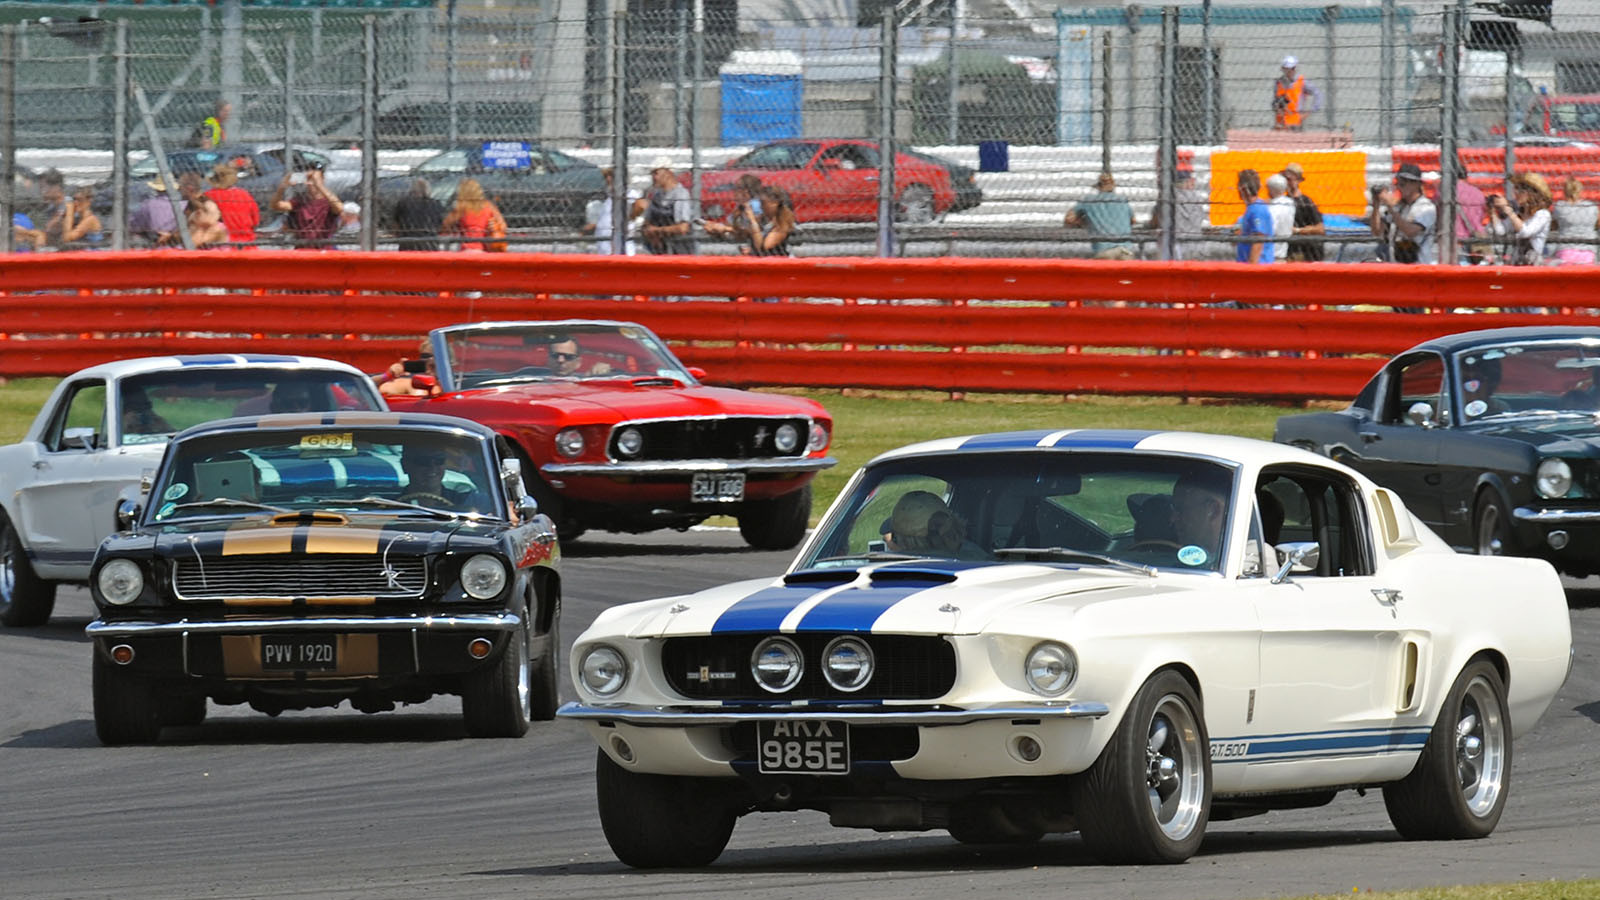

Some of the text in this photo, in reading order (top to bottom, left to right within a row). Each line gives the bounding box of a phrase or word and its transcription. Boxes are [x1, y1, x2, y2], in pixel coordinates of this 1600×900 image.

[265, 644, 333, 662] PVV 192D
[763, 740, 846, 769] 985E
